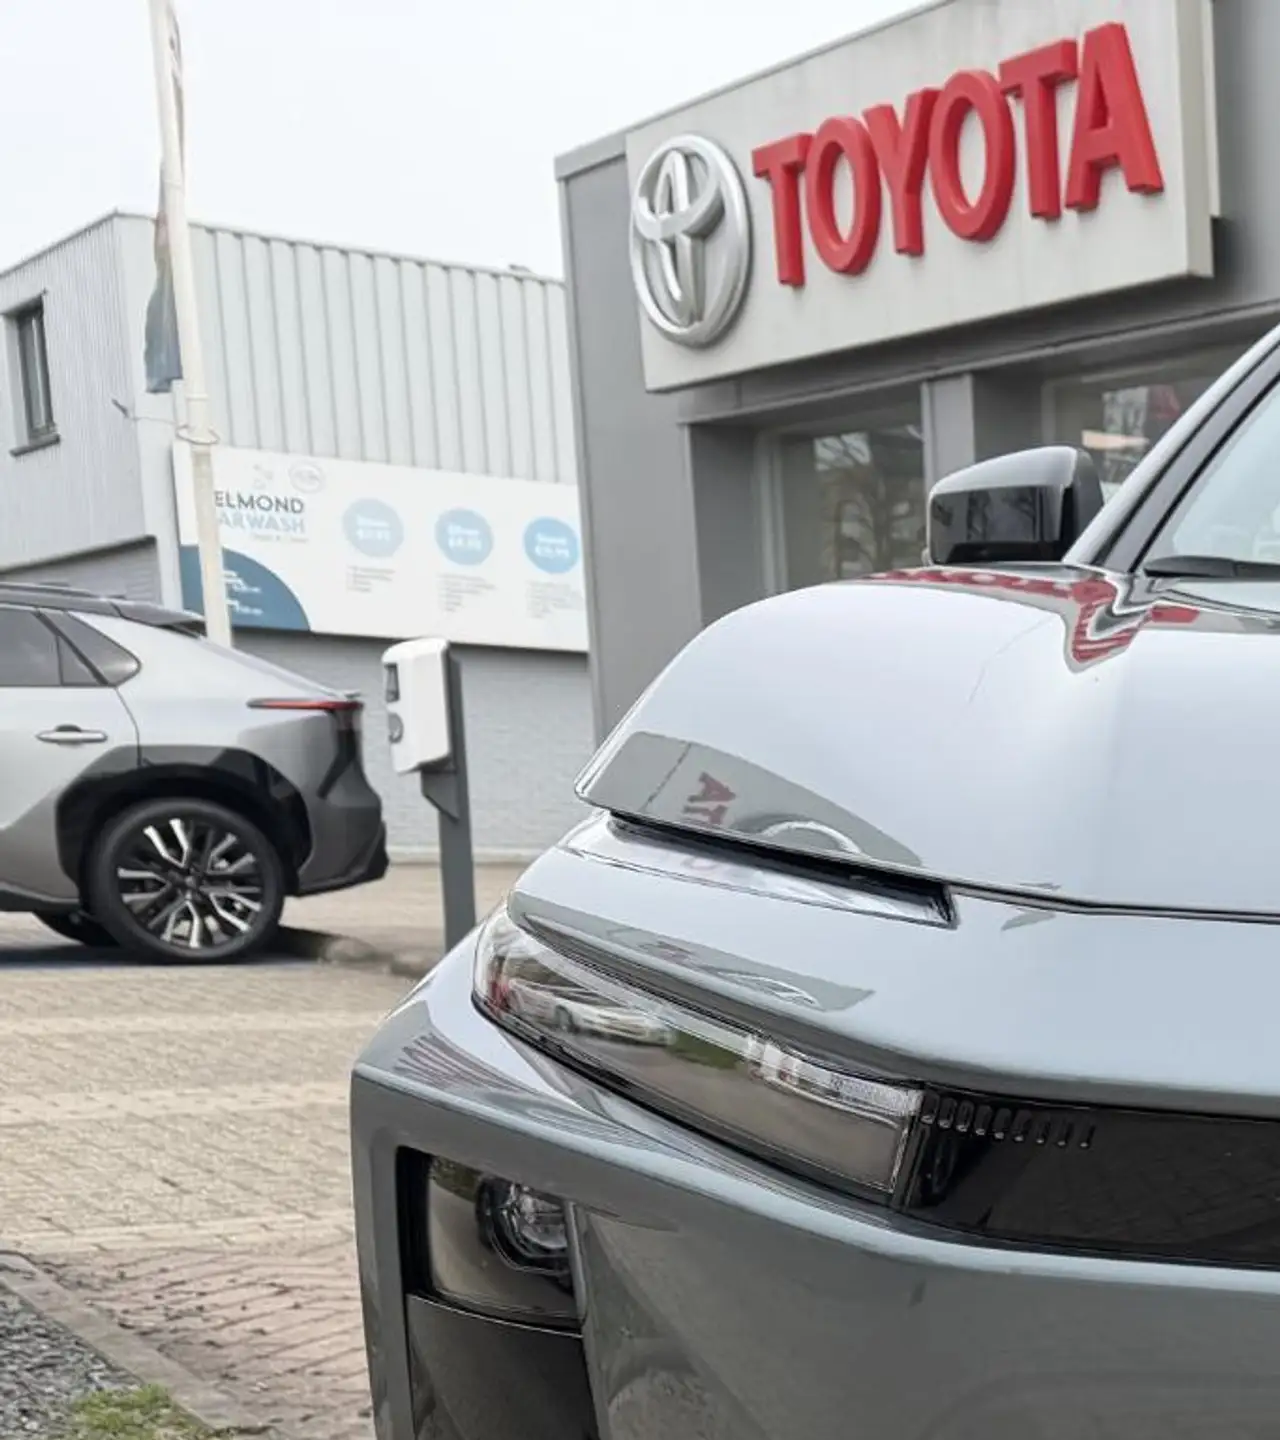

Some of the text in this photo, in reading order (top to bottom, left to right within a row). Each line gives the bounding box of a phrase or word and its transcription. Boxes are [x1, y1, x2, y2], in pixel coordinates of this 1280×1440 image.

[752, 22, 1164, 288] TOYOTA
[214, 490, 304, 514] ELMOND
[218, 511, 306, 534] ARWASH
